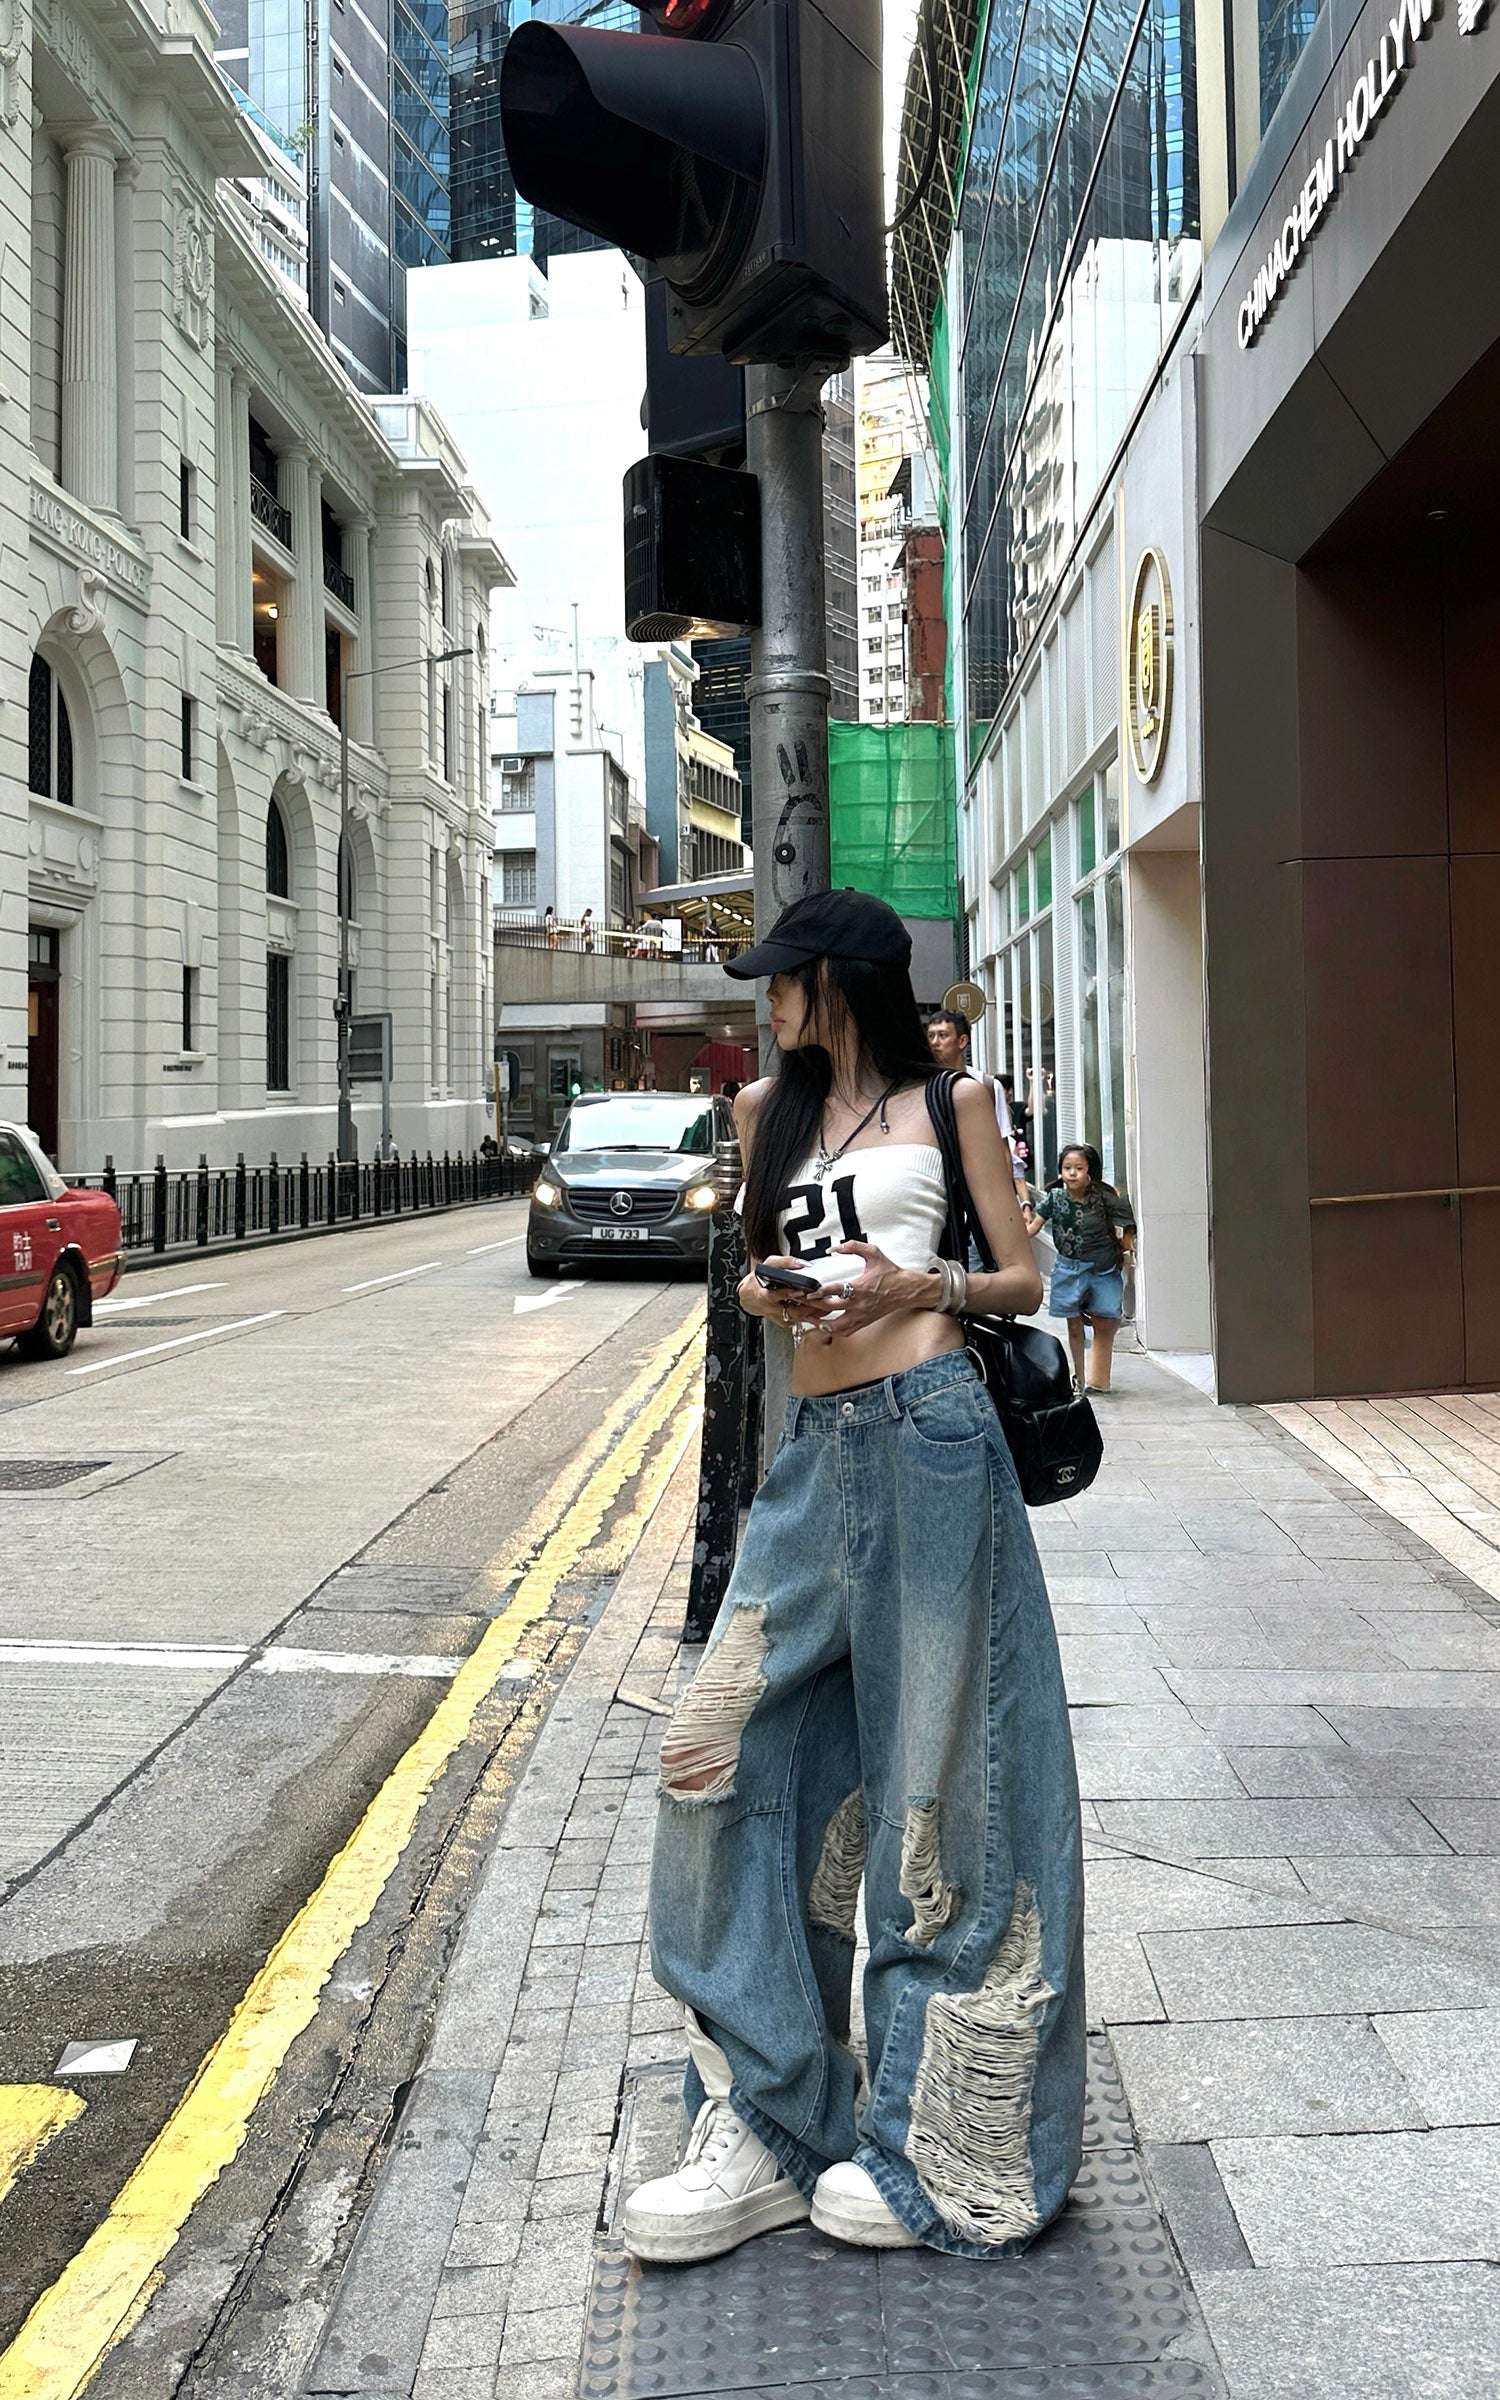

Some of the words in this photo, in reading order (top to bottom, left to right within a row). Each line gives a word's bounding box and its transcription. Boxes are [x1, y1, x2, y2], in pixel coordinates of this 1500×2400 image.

[1237, 139, 1334, 350] CHINACHEM
[68, 516, 102, 562] KONG
[105, 544, 146, 595] POLICE
[600, 1229, 615, 1239] UG
[619, 1229, 640, 1239] 733
[779, 1174, 868, 1262] 21
[14, 1251, 32, 1271] TAXI
